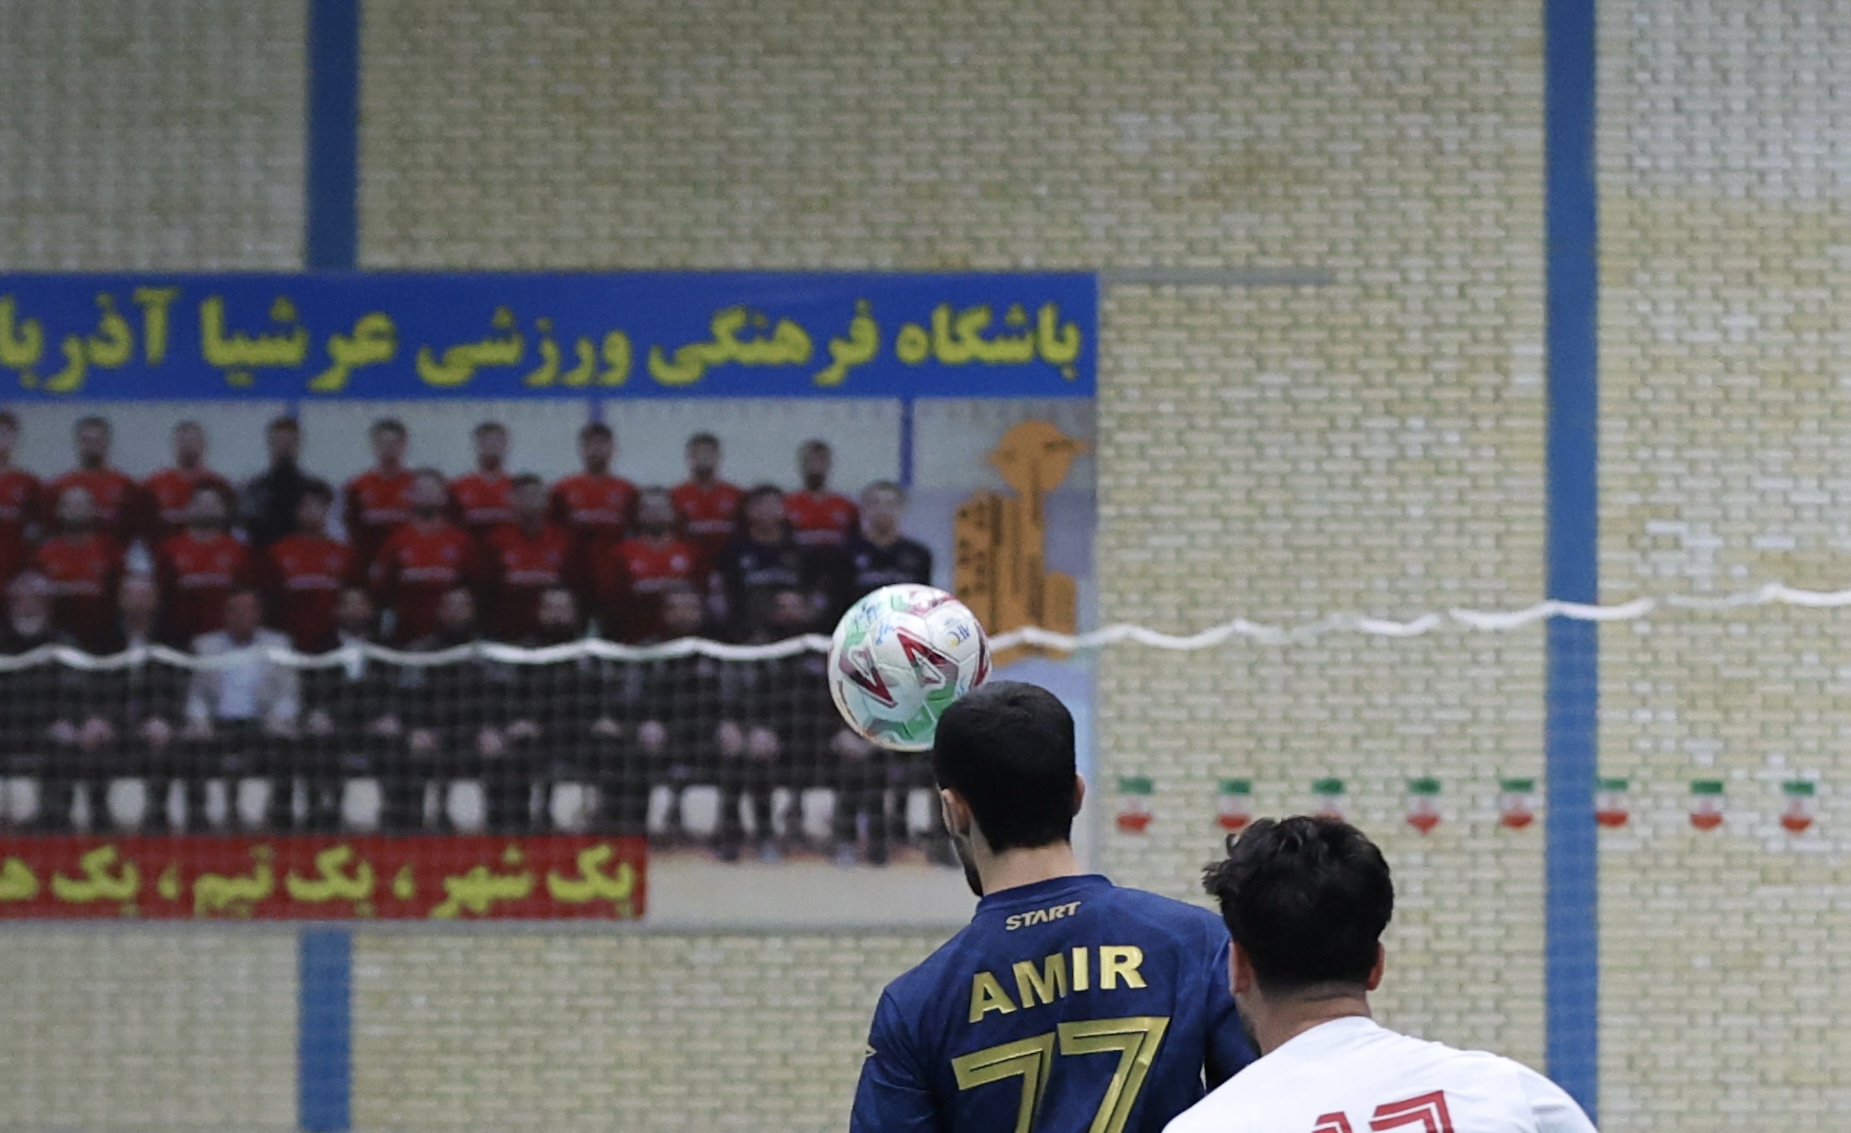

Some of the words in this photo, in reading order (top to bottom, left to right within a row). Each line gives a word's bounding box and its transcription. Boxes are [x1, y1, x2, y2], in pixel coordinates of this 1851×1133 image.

[203, 295, 397, 391] عرشیا
[414, 306, 632, 386] ورزشی
[647, 299, 878, 386] فرهنگی
[896, 303, 1081, 381] باشگاه
[52, 844, 140, 918] یک
[193, 844, 274, 920] تیم
[286, 844, 375, 918] یک
[430, 844, 535, 919] شهر
[547, 844, 634, 918] یک
[1005, 901, 1081, 931] START
[969, 945, 1147, 1023] AMIR
